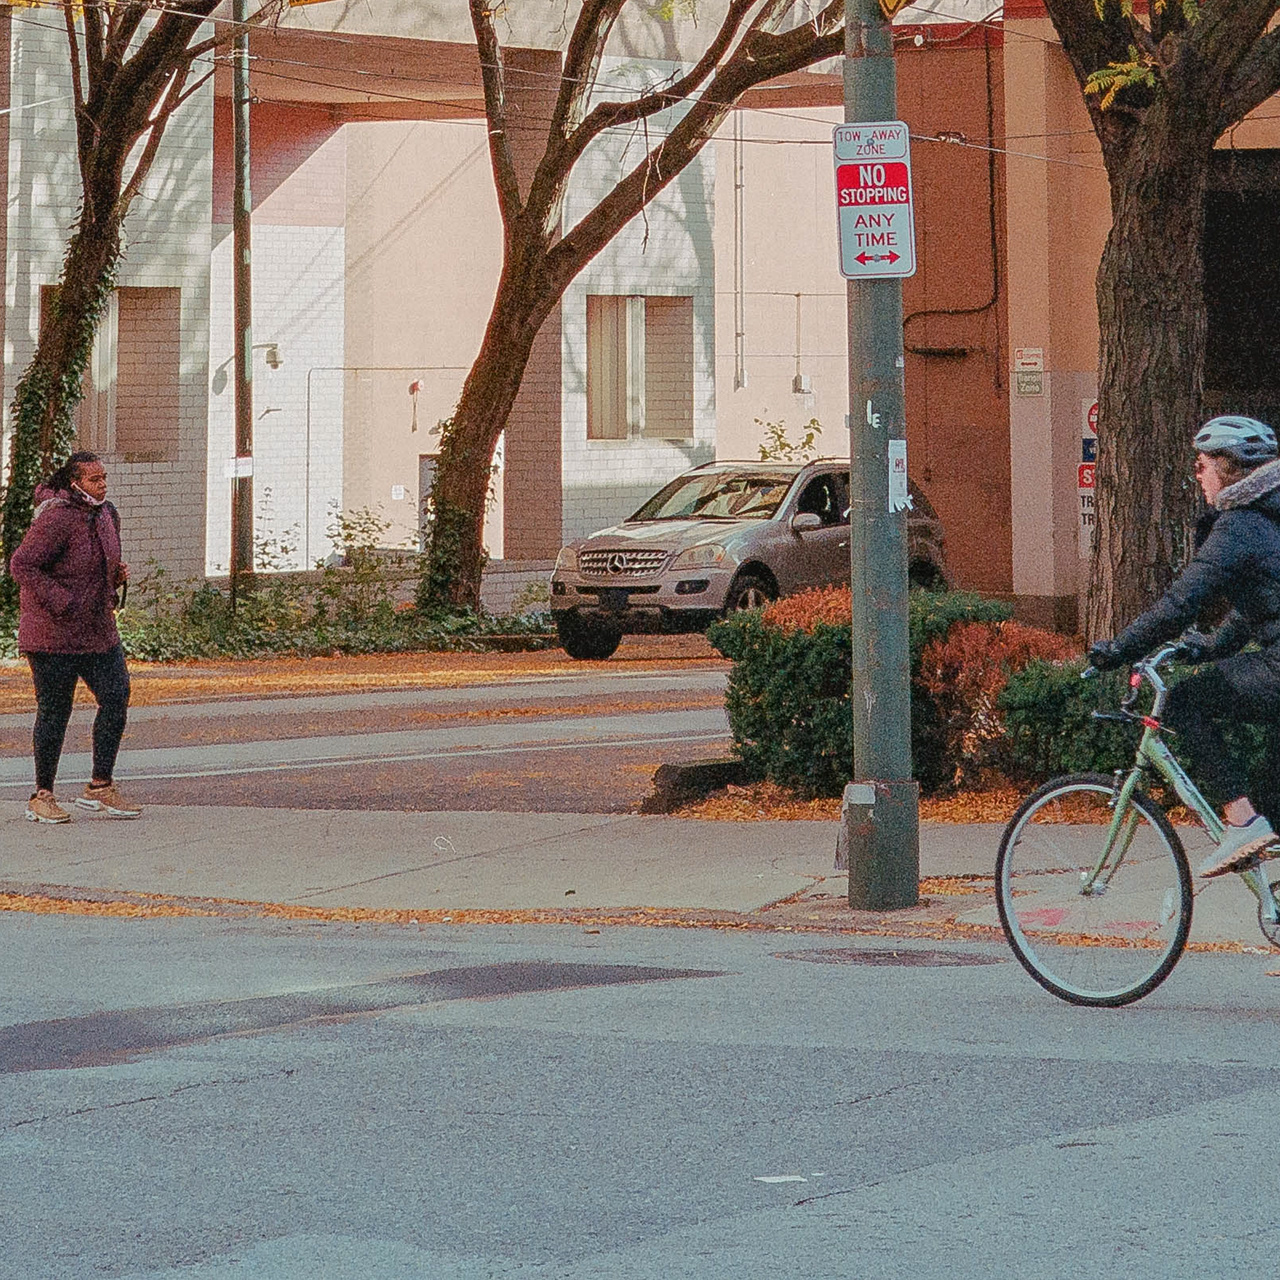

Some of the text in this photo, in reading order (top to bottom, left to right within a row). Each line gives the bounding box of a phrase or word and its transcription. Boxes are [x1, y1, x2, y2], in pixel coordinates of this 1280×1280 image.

[856, 144, 886, 156] ZONE
[858, 164, 886, 187] NO
[840, 187, 907, 204] STOPPING
[854, 213, 895, 229] ANY
[854, 232, 898, 247] TIME
